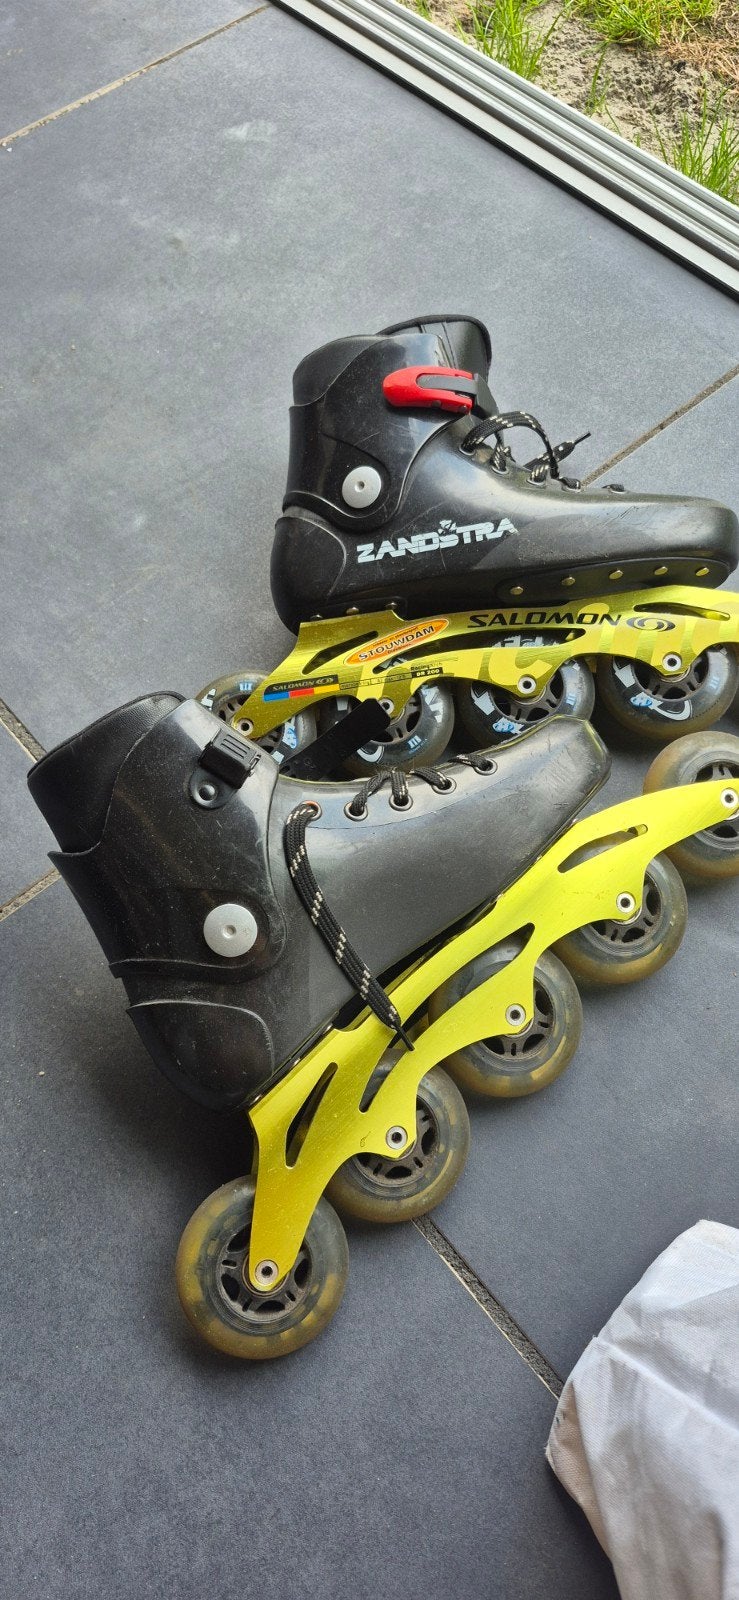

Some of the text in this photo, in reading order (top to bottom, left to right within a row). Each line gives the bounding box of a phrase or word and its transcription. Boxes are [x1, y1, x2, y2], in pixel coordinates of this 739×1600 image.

[356, 517, 520, 564] ZANDSTRA
[467, 611, 622, 629] SALOMON
[358, 625, 435, 661] STOUWDAM
[272, 680, 315, 692] SALOMON
